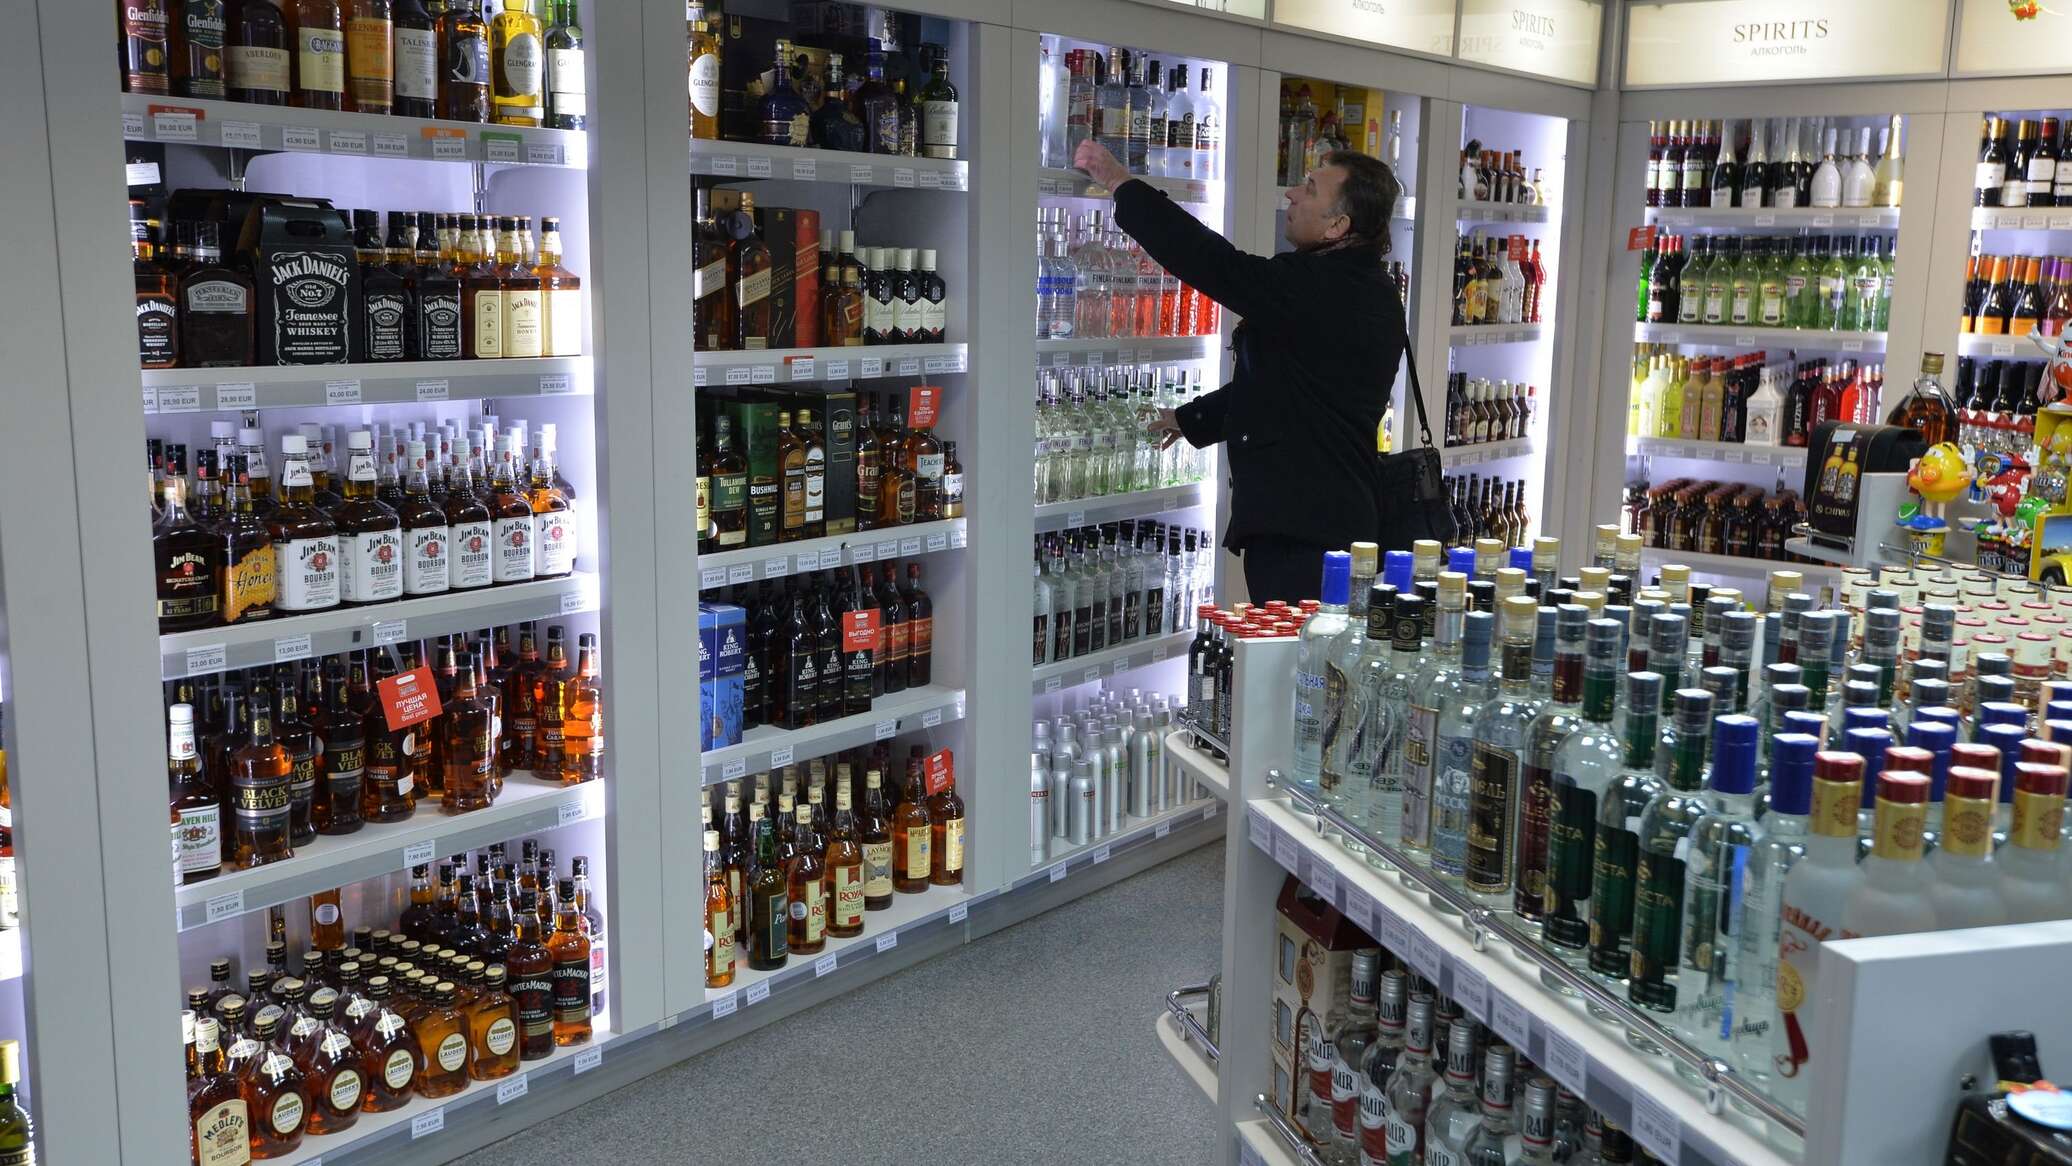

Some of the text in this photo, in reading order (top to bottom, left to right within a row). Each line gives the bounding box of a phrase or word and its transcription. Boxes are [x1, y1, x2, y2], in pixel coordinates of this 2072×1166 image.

[1512, 9, 1555, 38] SPIRITS
[1733, 18, 1830, 43] SPIRITS
[1750, 43, 1808, 57] АЛКОГОЛЬ
[127, 126, 144, 134] EUR
[272, 255, 350, 286] JACK DANIEL'S
[286, 327, 338, 335] WHISKEY
[459, 530, 472, 542] JIM
[501, 525, 514, 537] JIM
[367, 538, 382, 552] JIM
[415, 534, 429, 548] JIM
[301, 541, 336, 560] JIM BEAM
[170, 555, 186, 568] JIM
[418, 559, 446, 569] BOURBON
[461, 553, 489, 563] BOURBON
[304, 572, 335, 584] BOURBON
[719, 648, 742, 658] ROBERT
[723, 642, 739, 652] KING
[403, 701, 424, 713] ЦЕНА
[243, 787, 286, 800] BLACK
[241, 796, 288, 810] VELVET
[181, 813, 217, 827] AVEN HILL
[420, 850, 432, 858] EUR
[225, 901, 239, 911] EUR
[203, 1115, 245, 1141] MEDLEY'S
[428, 1118, 440, 1127] EUR
[210, 1144, 243, 1162] BOURBON
